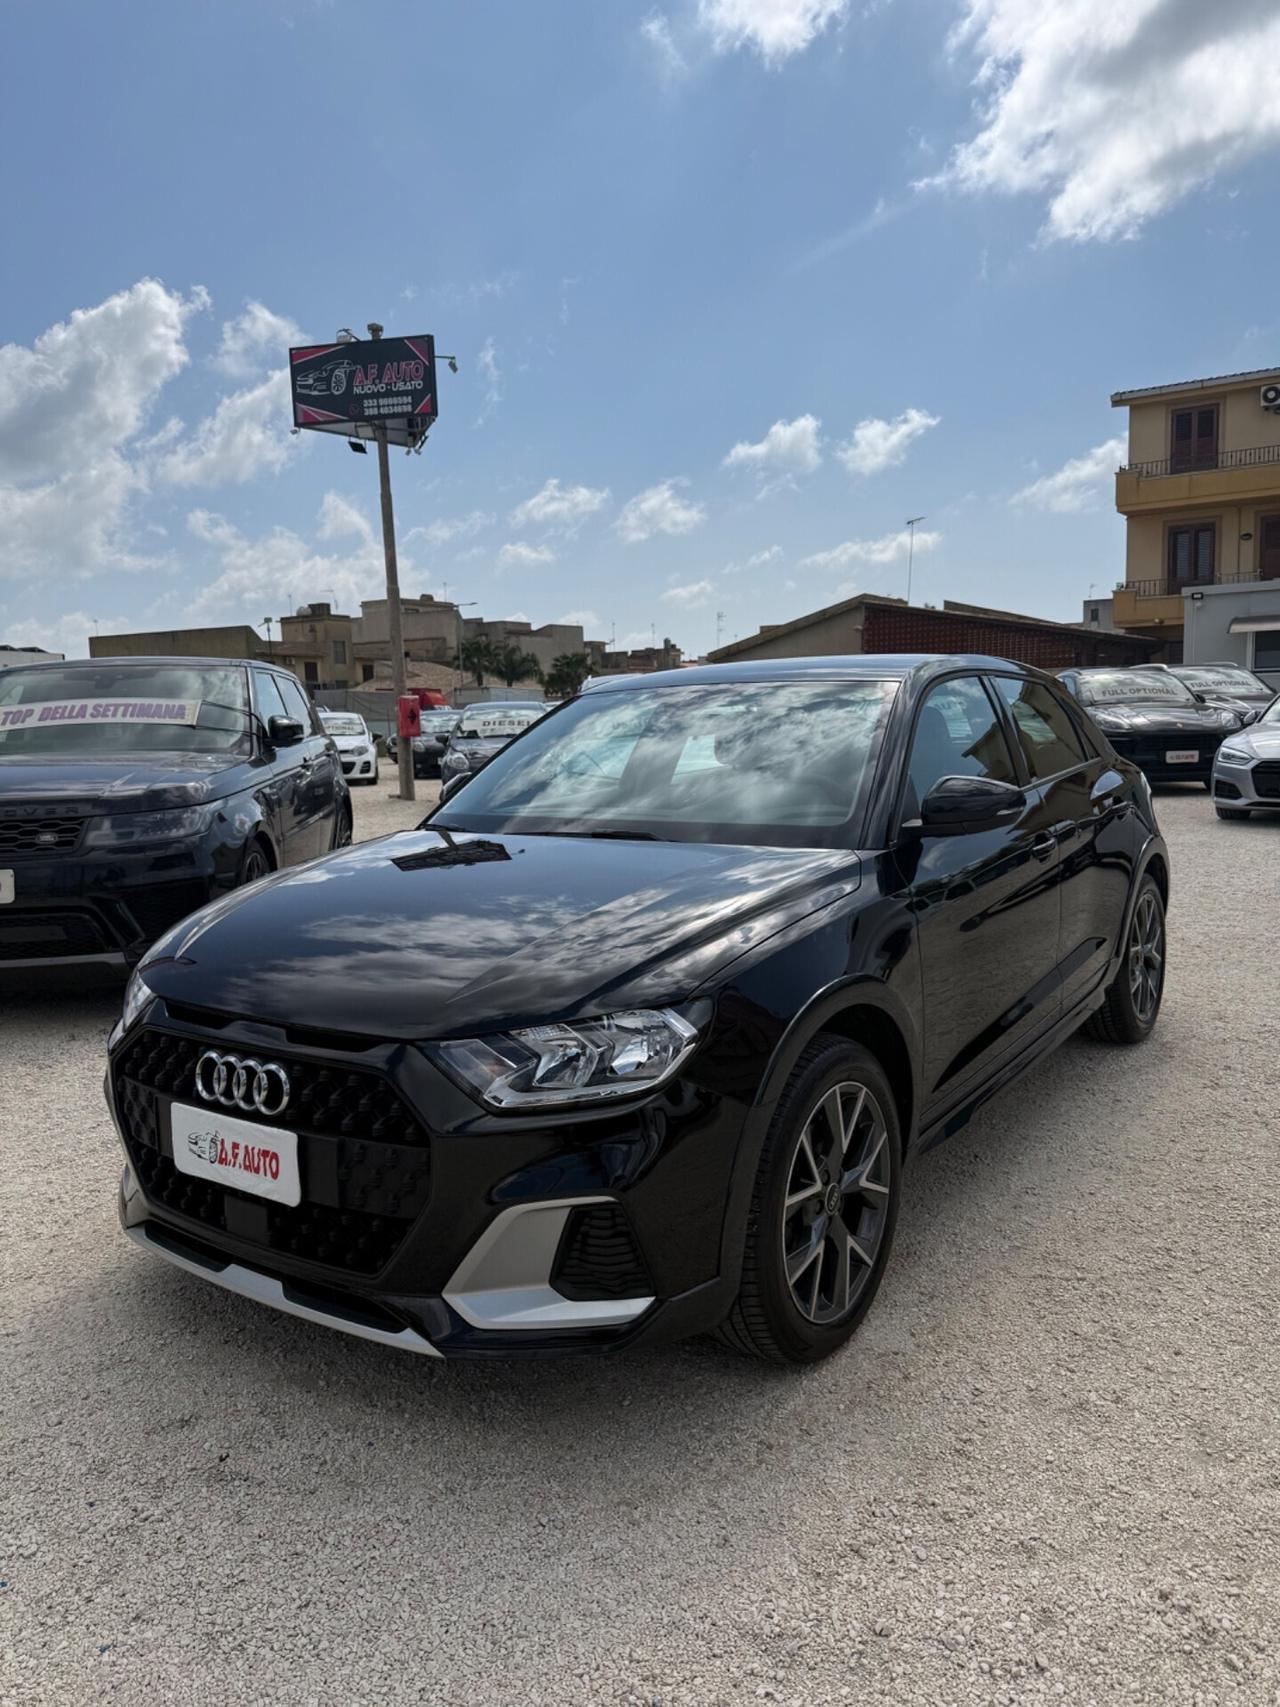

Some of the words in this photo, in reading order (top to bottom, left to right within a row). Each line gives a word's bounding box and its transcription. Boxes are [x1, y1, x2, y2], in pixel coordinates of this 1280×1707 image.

[381, 360, 424, 383] AUTO
[1102, 687, 1126, 697] FULL
[1128, 687, 1178, 697] OPTIONAL
[0, 708, 34, 726] TOP
[37, 703, 88, 722] DELLA
[90, 702, 186, 720] SETTIMANA
[4, 806, 79, 817] OVER
